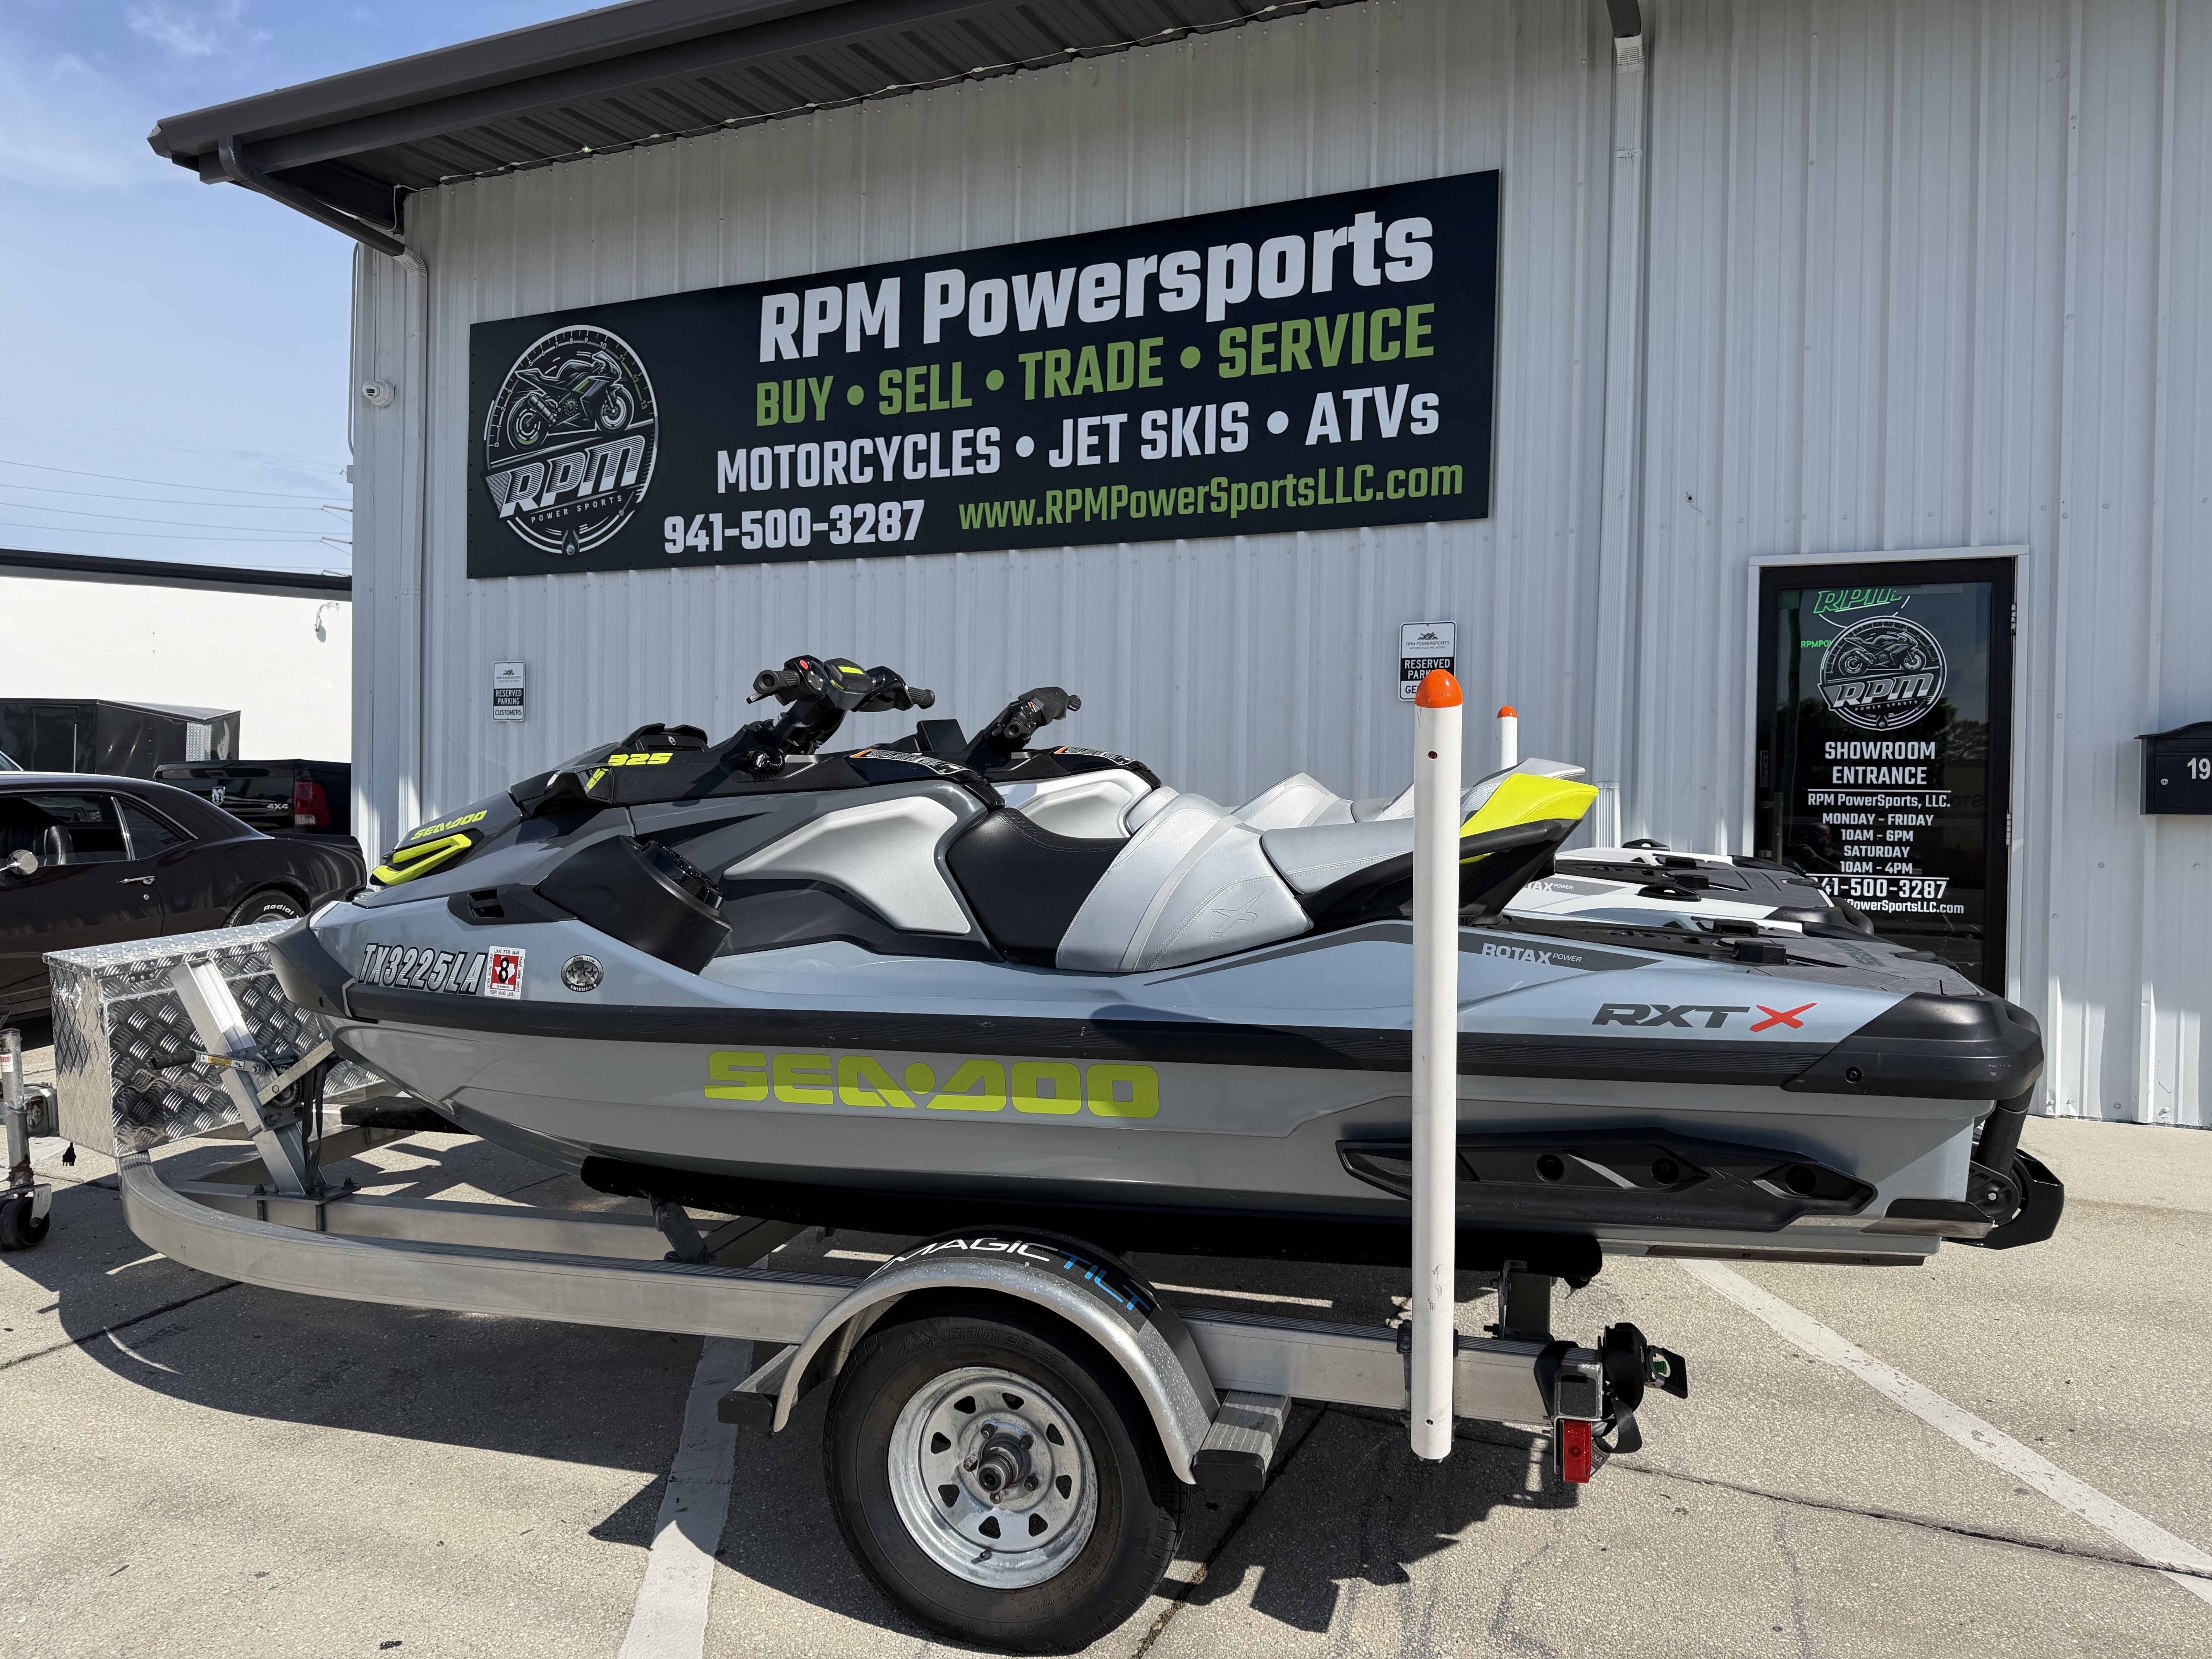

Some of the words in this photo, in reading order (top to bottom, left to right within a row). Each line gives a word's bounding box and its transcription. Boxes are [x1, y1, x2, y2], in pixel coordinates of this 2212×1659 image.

[760, 277, 900, 362] RPM
[924, 211, 1432, 344] Powersports
[757, 376, 833, 426] BUY
[879, 362, 972, 414] SELL
[1019, 337, 1163, 400] TRADE
[1219, 303, 1434, 378] SERVICE
[718, 427, 1000, 493] MOTORCYCLES
[1049, 414, 1127, 467] JET
[1141, 402, 1249, 459] SKIS
[1305, 384, 1439, 445] ATVs
[500, 435, 646, 518] RPM
[531, 508, 568, 523] POWER
[577, 495, 623, 512] SPORTS
[665, 500, 924, 553] 941-500-3287
[959, 465, 1462, 529] www.RPMPowerSportsLLC.com
[1801, 640, 1832, 648] RPMPO
[1405, 659, 1450, 669] RESERVED
[1408, 670, 1434, 679] PARK
[496, 689, 522, 697] RESERVED
[1833, 673, 1934, 707] RPM
[608, 753, 673, 766] 325
[1825, 742, 1935, 759] SHOWROOM
[1832, 766, 1927, 784] ENTRANCE
[2187, 757, 2212, 780] 19
[1808, 793, 1834, 805] RPM
[1838, 794, 1921, 809] PowerSports,
[1926, 795, 1950, 807] LLC.
[1823, 813, 1875, 824] MONDAY
[1888, 814, 1934, 826] FRIDAY
[1841, 830, 1873, 840] 10AM
[1887, 830, 1913, 842] 6PM
[1844, 845, 1910, 857] SATURDAY
[1840, 861, 1872, 872] 10AM
[1885, 862, 1912, 874] 4PM
[1527, 881, 1553, 891] TAX
[1844, 899, 1964, 913] PowerSportsLLC.com
[1482, 943, 1552, 965] ROTAX
[1553, 953, 1582, 962] POWER
[358, 943, 488, 995] TX3225LA
[498, 957, 510, 983] 8
[1591, 1003, 1751, 1029] RXT
[1060, 1250, 1150, 1310] TILT
[949, 1327, 1034, 1351] RAINIER
[1037, 1348, 1067, 1367] ST
